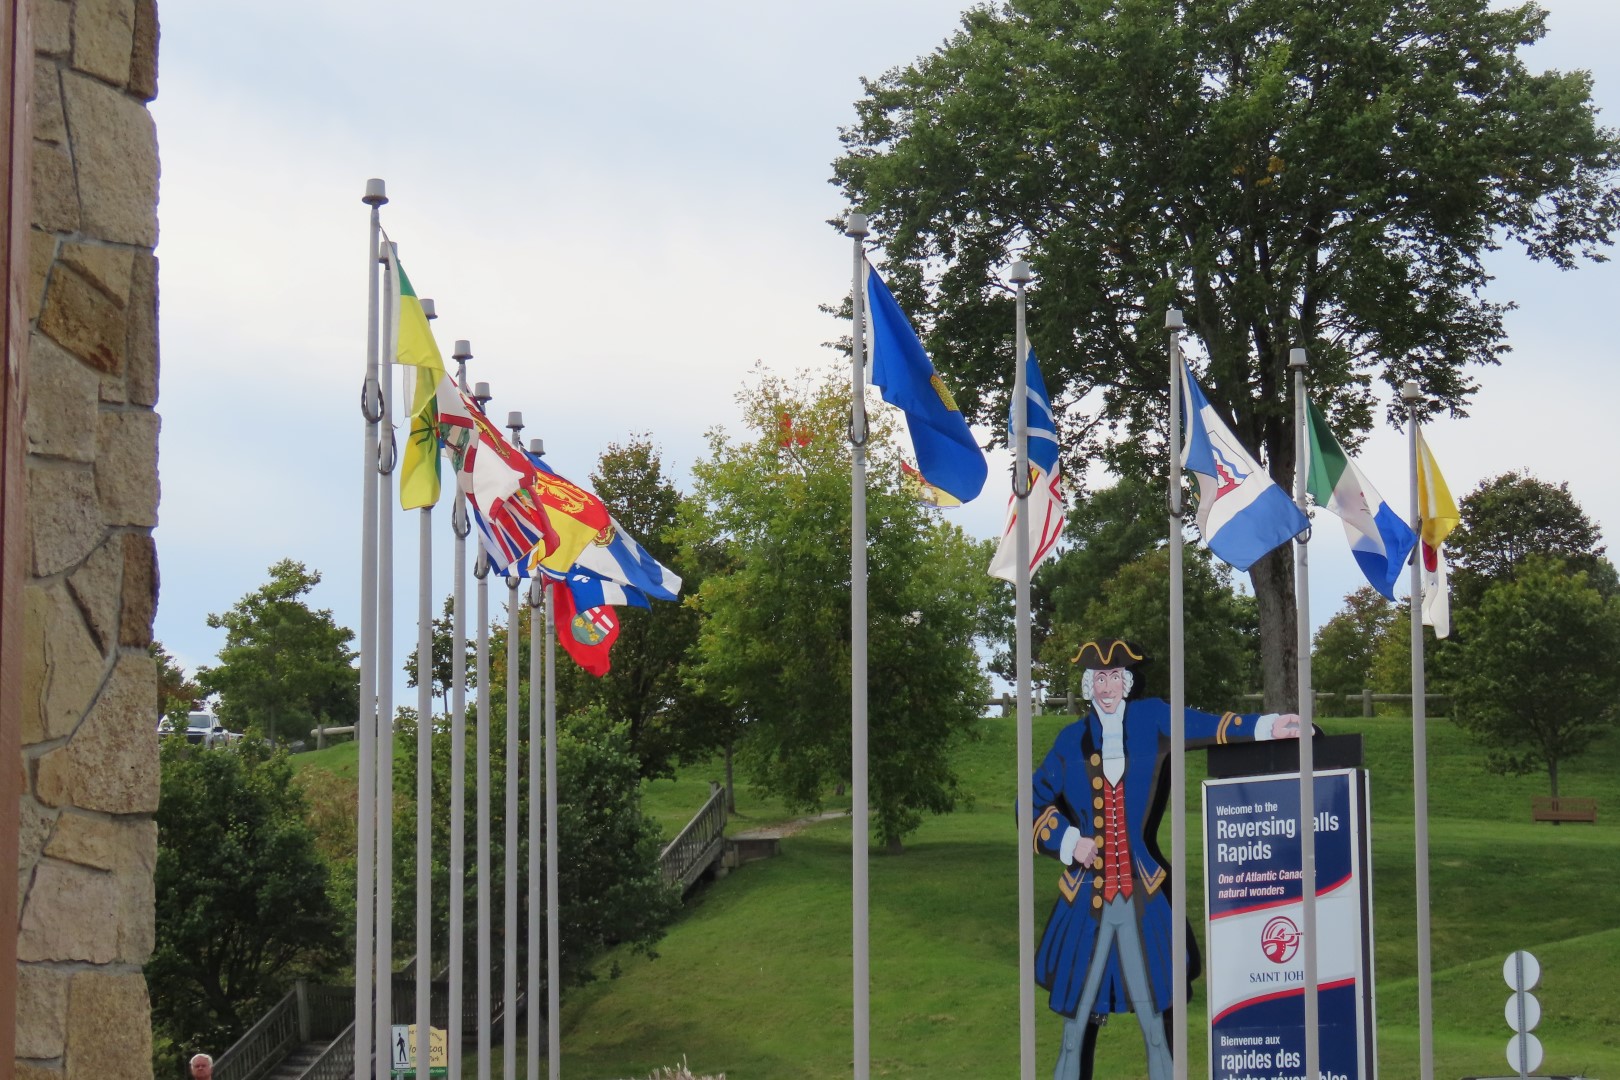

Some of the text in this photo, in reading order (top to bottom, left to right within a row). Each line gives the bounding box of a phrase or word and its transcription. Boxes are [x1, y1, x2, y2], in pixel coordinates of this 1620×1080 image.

[1216, 801, 1278, 816] Welcome to the
[1217, 811, 1339, 839] Reversing alls
[1217, 841, 1272, 865] Rapids
[1218, 873, 1234, 884] One
[1235, 872, 1246, 882] of
[1245, 870, 1277, 882] Atlantic
[1218, 885, 1285, 899] natural wonders
[1249, 970, 1304, 983] SAINT JOH
[1220, 1036, 1280, 1046] Bienvenue aux
[1221, 1048, 1300, 1074] rapides des
